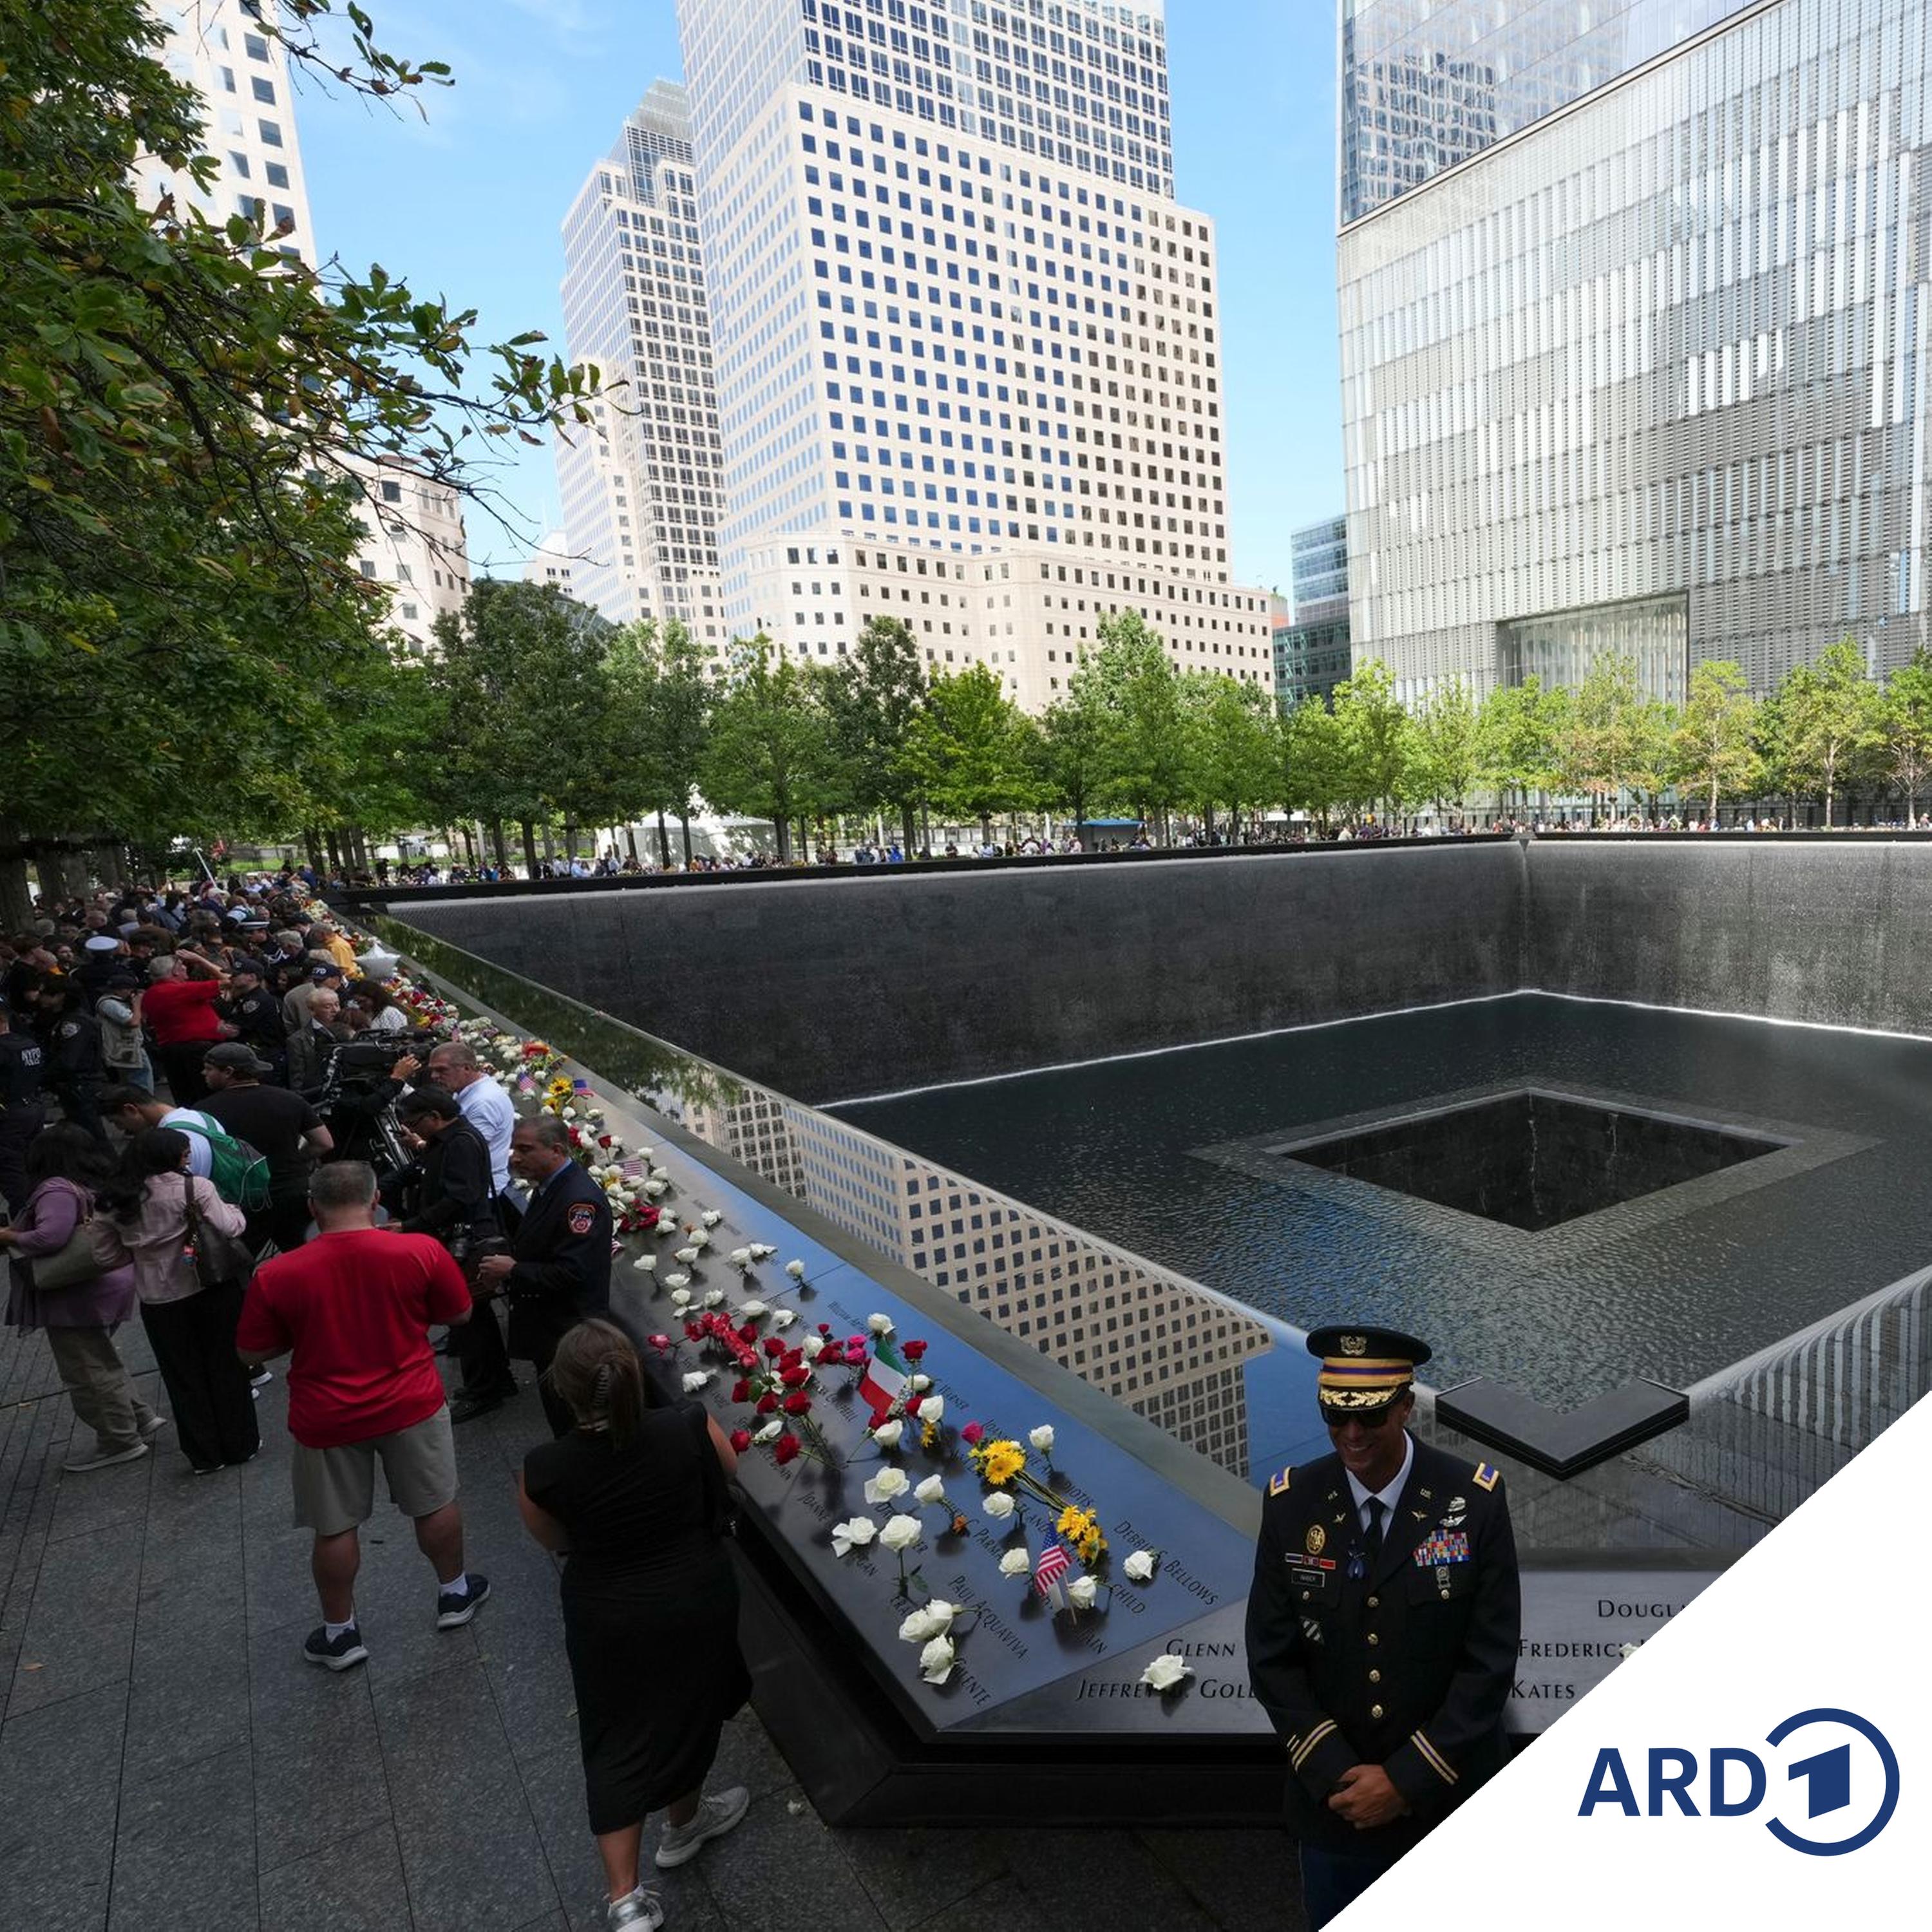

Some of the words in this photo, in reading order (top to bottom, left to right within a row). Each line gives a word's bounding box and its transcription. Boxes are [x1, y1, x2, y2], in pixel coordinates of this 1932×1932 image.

[1164, 1560, 1219, 1605] BELLOWS
[947, 1575, 976, 1602] PAUL
[971, 1600, 1029, 1660] ACQUAVIVA
[1166, 1638, 1236, 1657] GLENN
[1511, 1679, 1575, 1700] KATES
